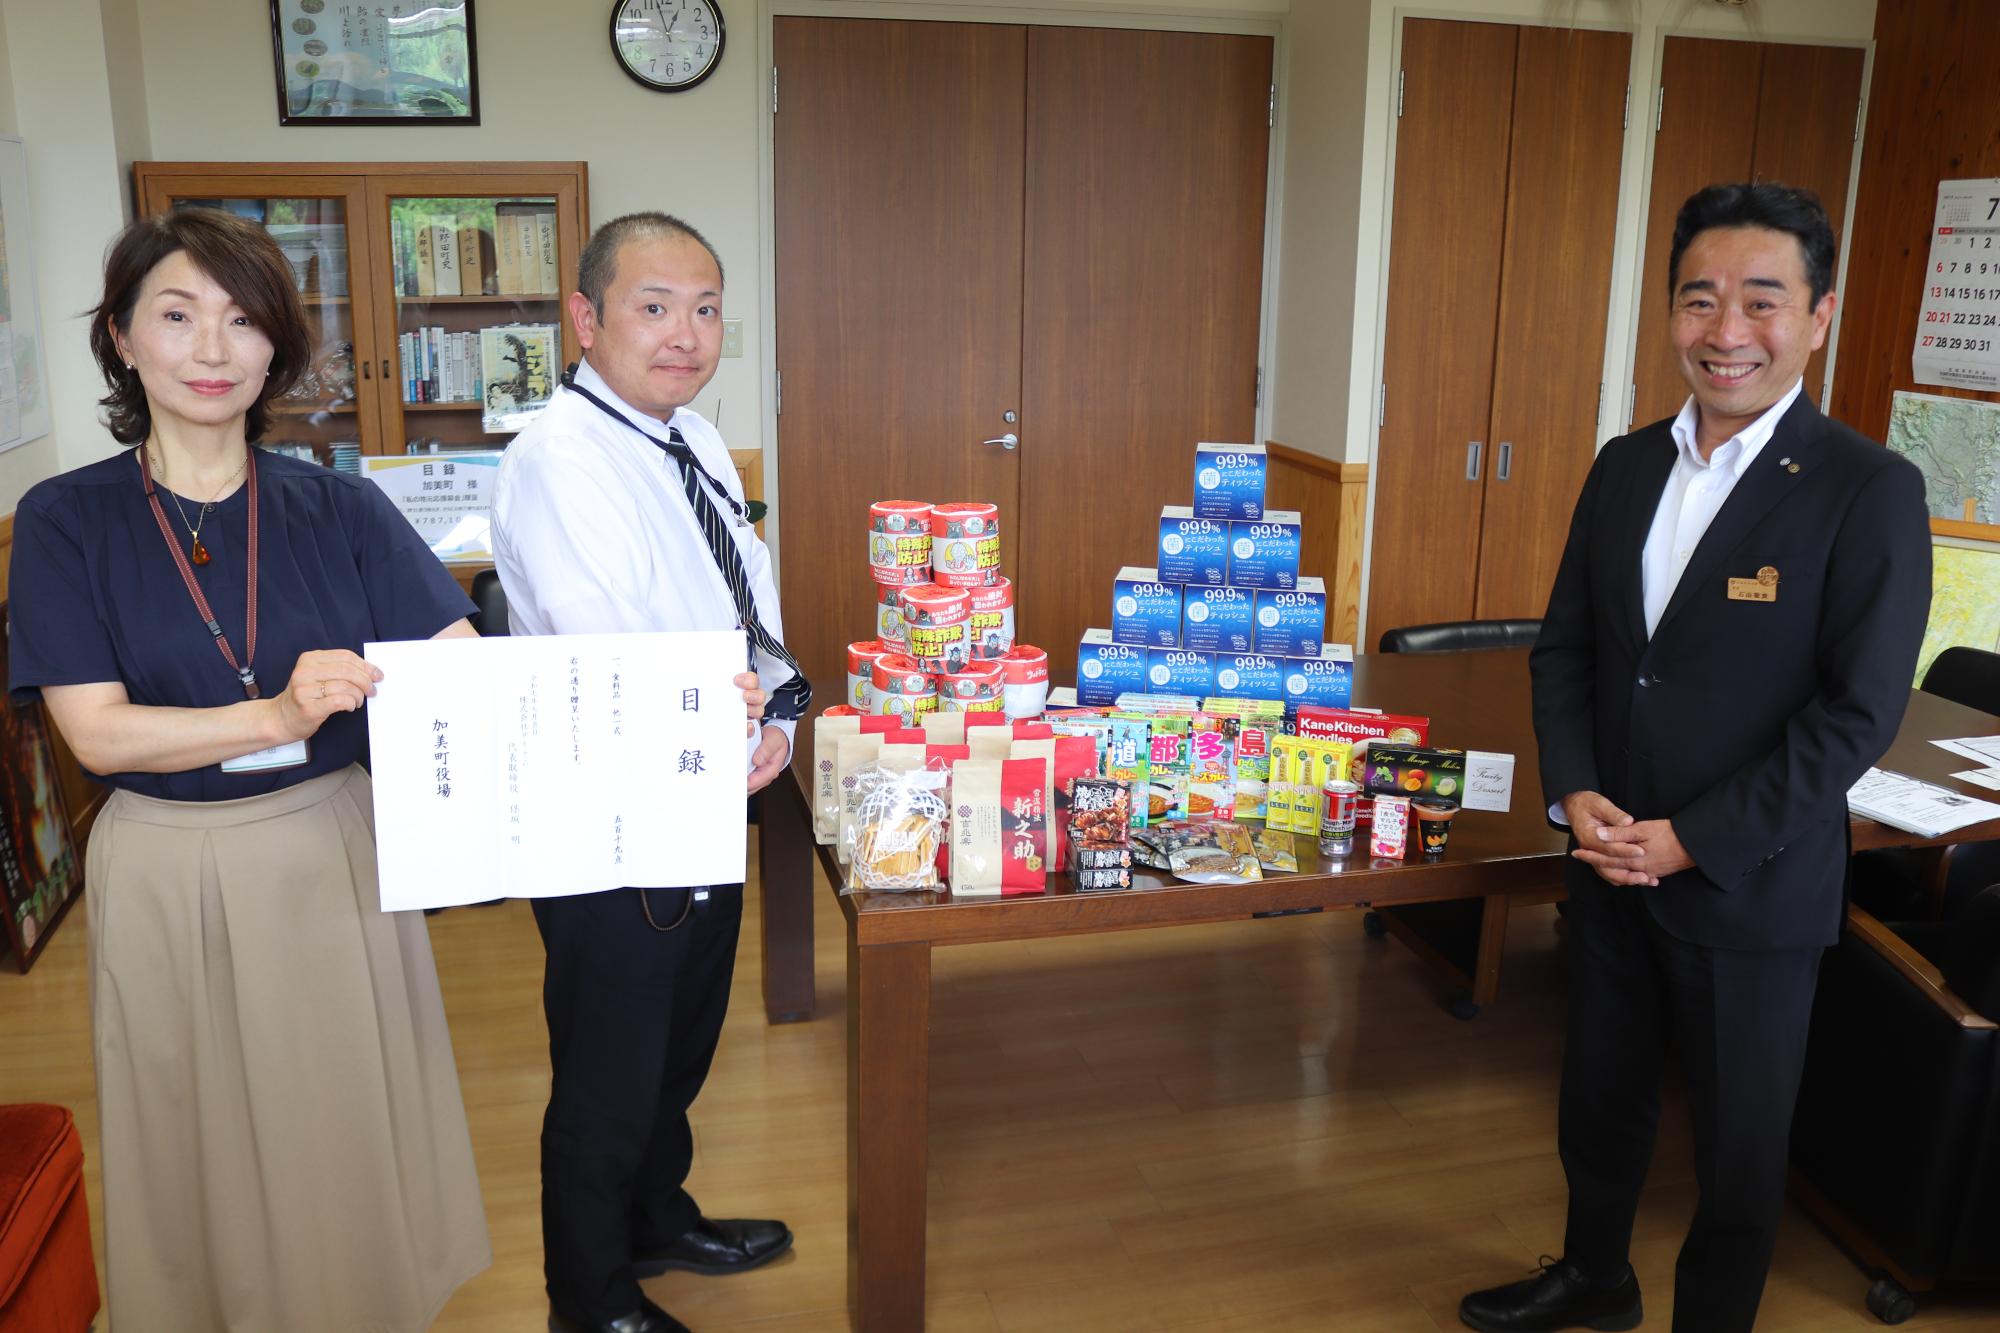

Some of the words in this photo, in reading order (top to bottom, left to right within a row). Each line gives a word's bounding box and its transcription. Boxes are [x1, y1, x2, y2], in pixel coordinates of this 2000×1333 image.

[630, 9, 642, 23] 10
[694, 8, 702, 22] 2
[700, 26, 708, 40] 3
[634, 46, 642, 60] 8
[696, 44, 704, 58] 4
[650, 59, 656, 72] 7
[666, 63, 674, 77] 6
[683, 58, 691, 72] 5
[1987, 198, 2000, 220] 7
[1970, 237, 1975, 249] 1
[1984, 237, 1992, 249] 2
[1936, 262, 1943, 273] 6
[1950, 262, 1957, 273] 7
[1964, 262, 1971, 274] 8
[1980, 263, 1987, 274] 9
[1930, 286, 1942, 298] 13
[1944, 287, 1956, 299] 14
[1958, 287, 1971, 299] 15
[1974, 288, 1986, 300] 16
[1989, 289, 2000, 301] 17
[1925, 311, 1937, 323] 20
[1939, 311, 1950, 323] 21
[1953, 313, 1966, 324] 22
[1968, 313, 1981, 325] 23
[1983, 314, 1996, 326] 24
[1921, 336, 1934, 347] 27
[1936, 336, 1948, 348] 28
[1949, 337, 1962, 349] 29
[1963, 338, 1977, 350] 30
[1978, 339, 1990, 351] 31
[1216, 453, 1258, 469] 99.9%
[1222, 469, 1262, 477] にこだわった
[423, 480, 453, 490] 加美町
[468, 480, 477, 489] 様
[1222, 478, 1259, 487] ティッシュ
[1179, 520, 1221, 535] 99.9%
[1250, 524, 1292, 539] 99.9%
[1185, 535, 1225, 543] にこだわった
[1256, 539, 1296, 547] にこだわった
[1185, 544, 1222, 552] ティッシュ
[1256, 548, 1293, 557] ティッシュ
[1133, 584, 1174, 598] 99.9%
[1204, 588, 1246, 602] 99.9%
[1138, 597, 1177, 606] にこだわった
[1210, 602, 1249, 610] にこだわった
[1275, 593, 1317, 607] 99.9%
[1138, 606, 1175, 615] ティッシュ
[1210, 611, 1247, 619] ティッシュ
[1281, 607, 1321, 616] にこだわった
[1281, 616, 1318, 625] ティッシュ
[911, 625, 963, 642] 特殊詐欺
[912, 641, 943, 657] 防止!
[1098, 647, 1138, 661] 99.9%
[1104, 660, 1142, 668] にこだわった
[1166, 652, 1207, 666] 99.9%
[1235, 656, 1276, 670] 99.9%
[1104, 668, 1140, 677] ティッシュ
[1172, 666, 1210, 674] にこだわった
[1240, 670, 1279, 678] にこだわった
[1303, 661, 1345, 675] 99.9%
[612, 672, 621, 699] 食料品
[1172, 675, 1208, 683] ティッシュ
[1240, 679, 1277, 687] ティッシュ
[1309, 675, 1348, 683] にこだわった
[1309, 684, 1346, 692] ティッシュ
[570, 657, 581, 766] 右の通り贈呈いたします。
[612, 709, 622, 736] 他一式
[1300, 718, 1384, 736] KaneKitchen
[1240, 729, 1265, 757] 島
[1300, 730, 1353, 744] Noodles
[1112, 738, 1138, 767] 道
[1151, 734, 1180, 763] 都
[432, 718, 451, 799] 加美町役場
[1373, 752, 1395, 762] Grape
[1403, 753, 1430, 765] Mango
[508, 742, 519, 794] 代表取締役
[1436, 760, 1460, 769] Melon
[1473, 768, 1503, 782] Fruity
[1472, 782, 1507, 795] Dessert
[1013, 797, 1035, 860] 新之助
[612, 815, 623, 864] 五百十九点
